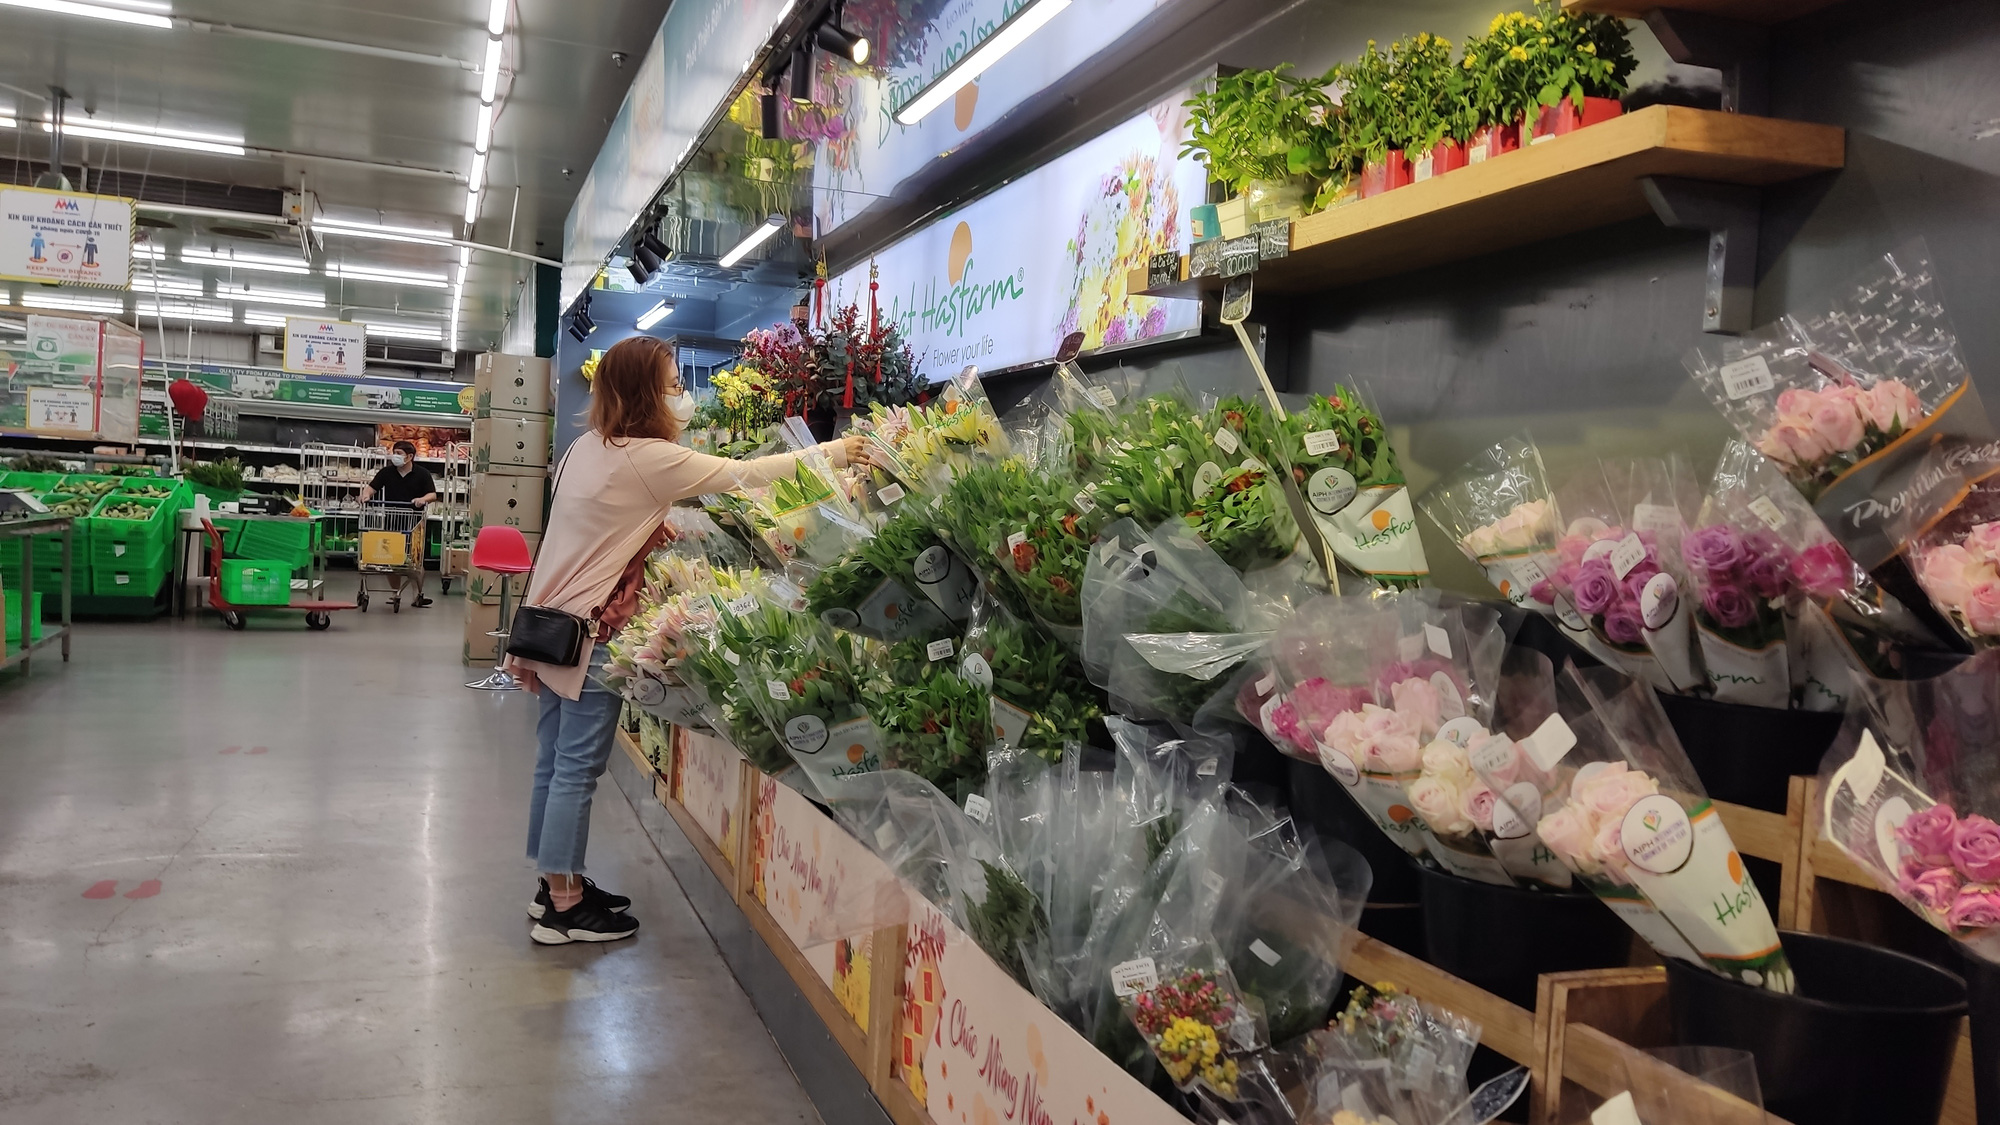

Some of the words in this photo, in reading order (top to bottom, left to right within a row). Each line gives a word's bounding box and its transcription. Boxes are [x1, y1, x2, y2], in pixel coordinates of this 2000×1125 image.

[933, 347, 958, 369] Flower
[961, 343, 980, 367] your
[981, 334, 994, 356] life
[219, 368, 245, 376] QUALITY
[1843, 466, 1945, 529] Premium
[1633, 839, 1655, 856] AIPH
[950, 999, 978, 1059] Chúc
[978, 1033, 1019, 1121] Mừng
